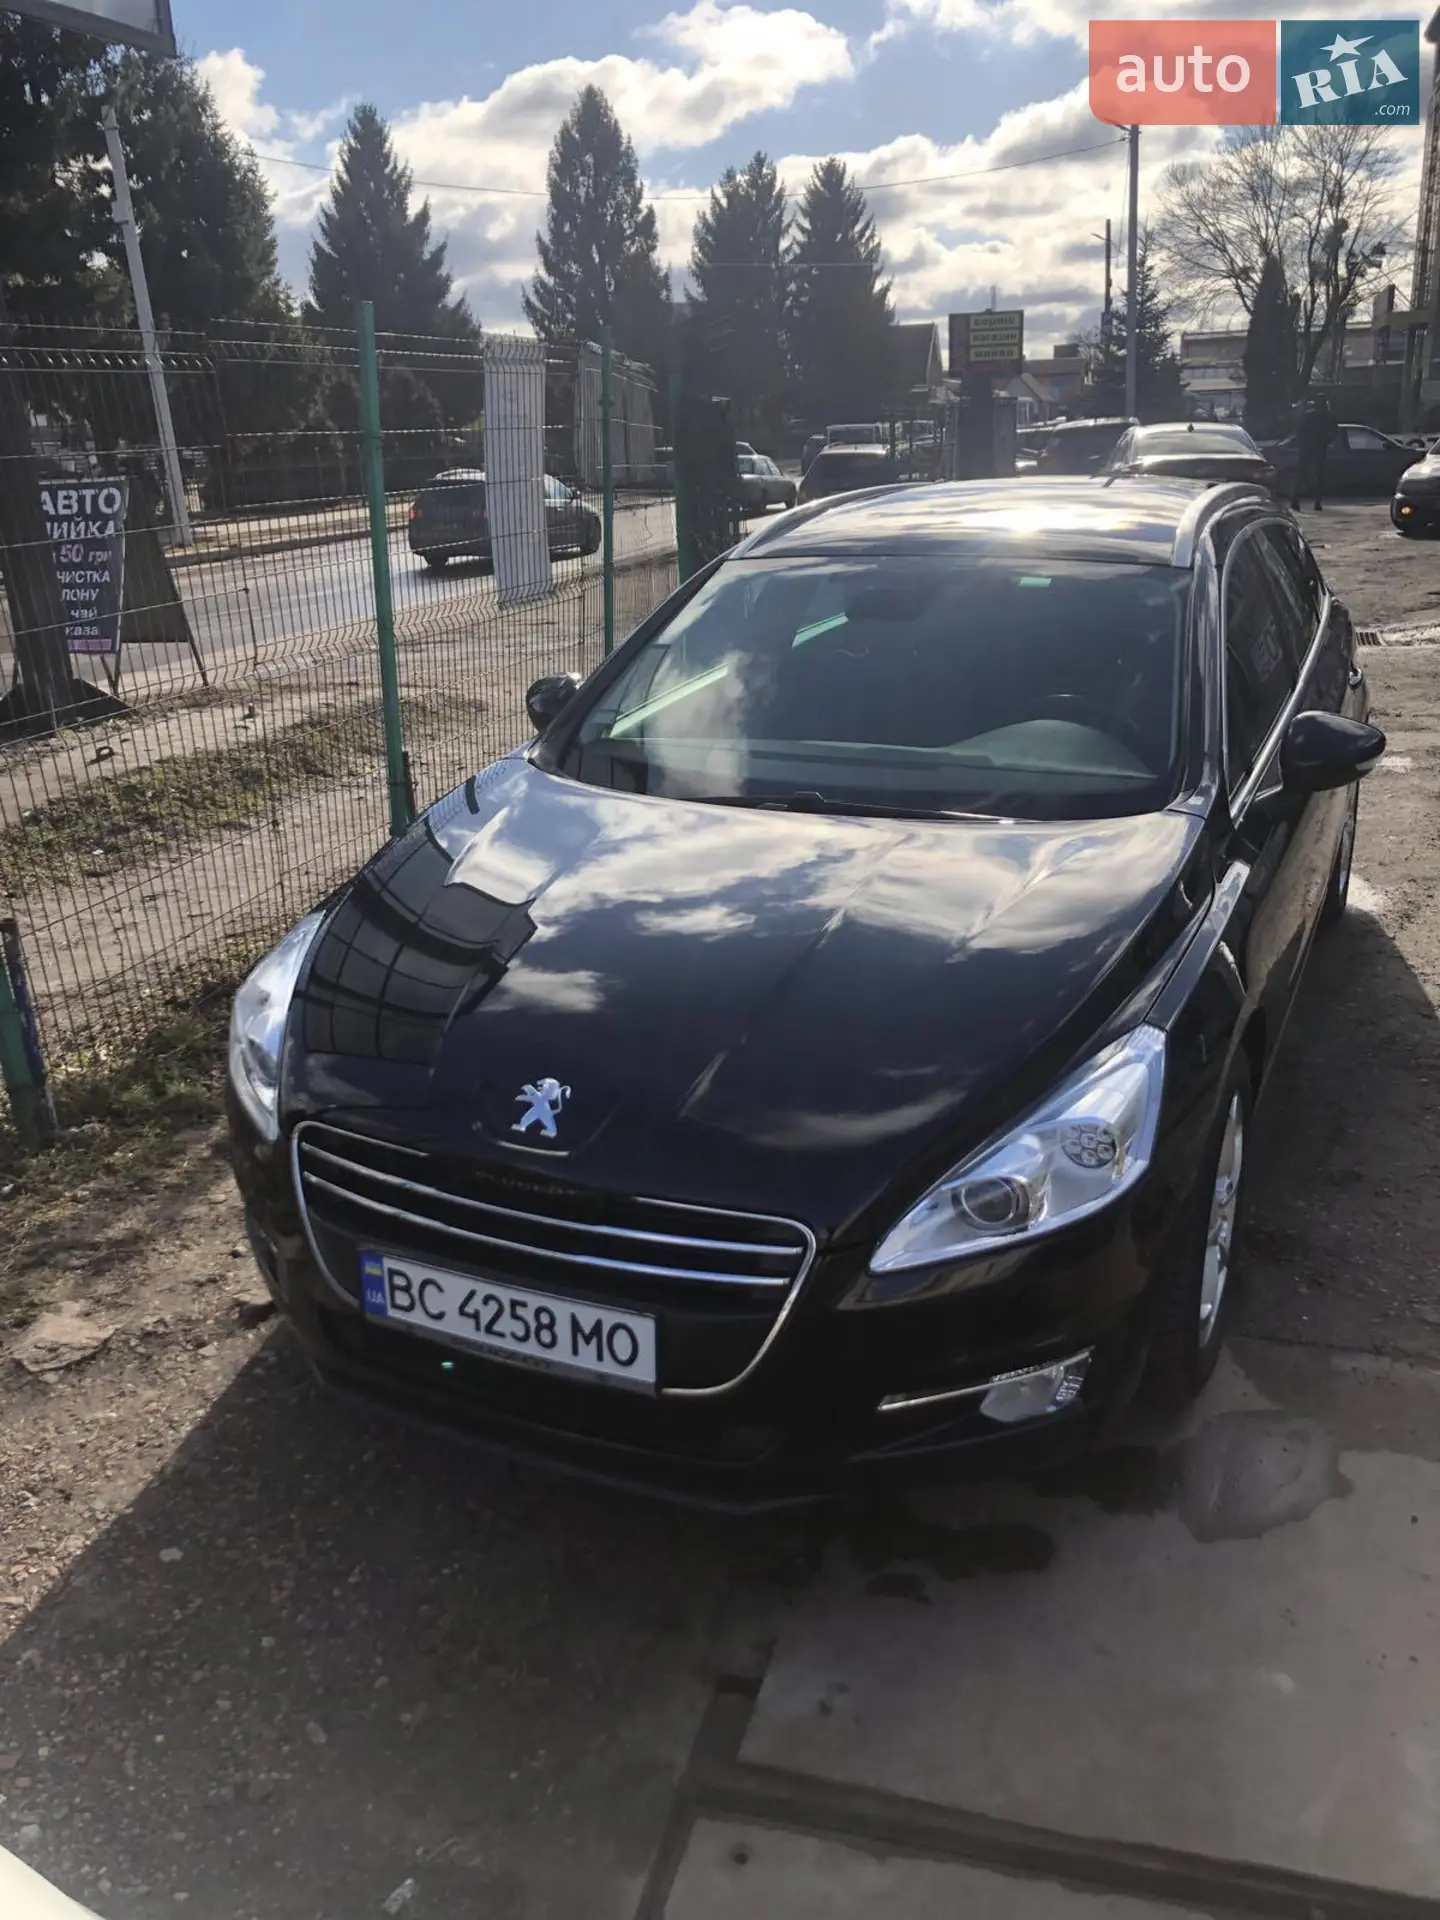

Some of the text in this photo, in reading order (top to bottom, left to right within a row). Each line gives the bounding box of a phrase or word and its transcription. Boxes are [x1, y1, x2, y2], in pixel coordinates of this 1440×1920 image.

[40, 487, 122, 516] АВТО
[56, 570, 110, 584] ЧИСТКА
[386, 1267, 446, 1321] BC
[458, 1289, 558, 1350] 4258
[570, 1311, 639, 1367] MO
